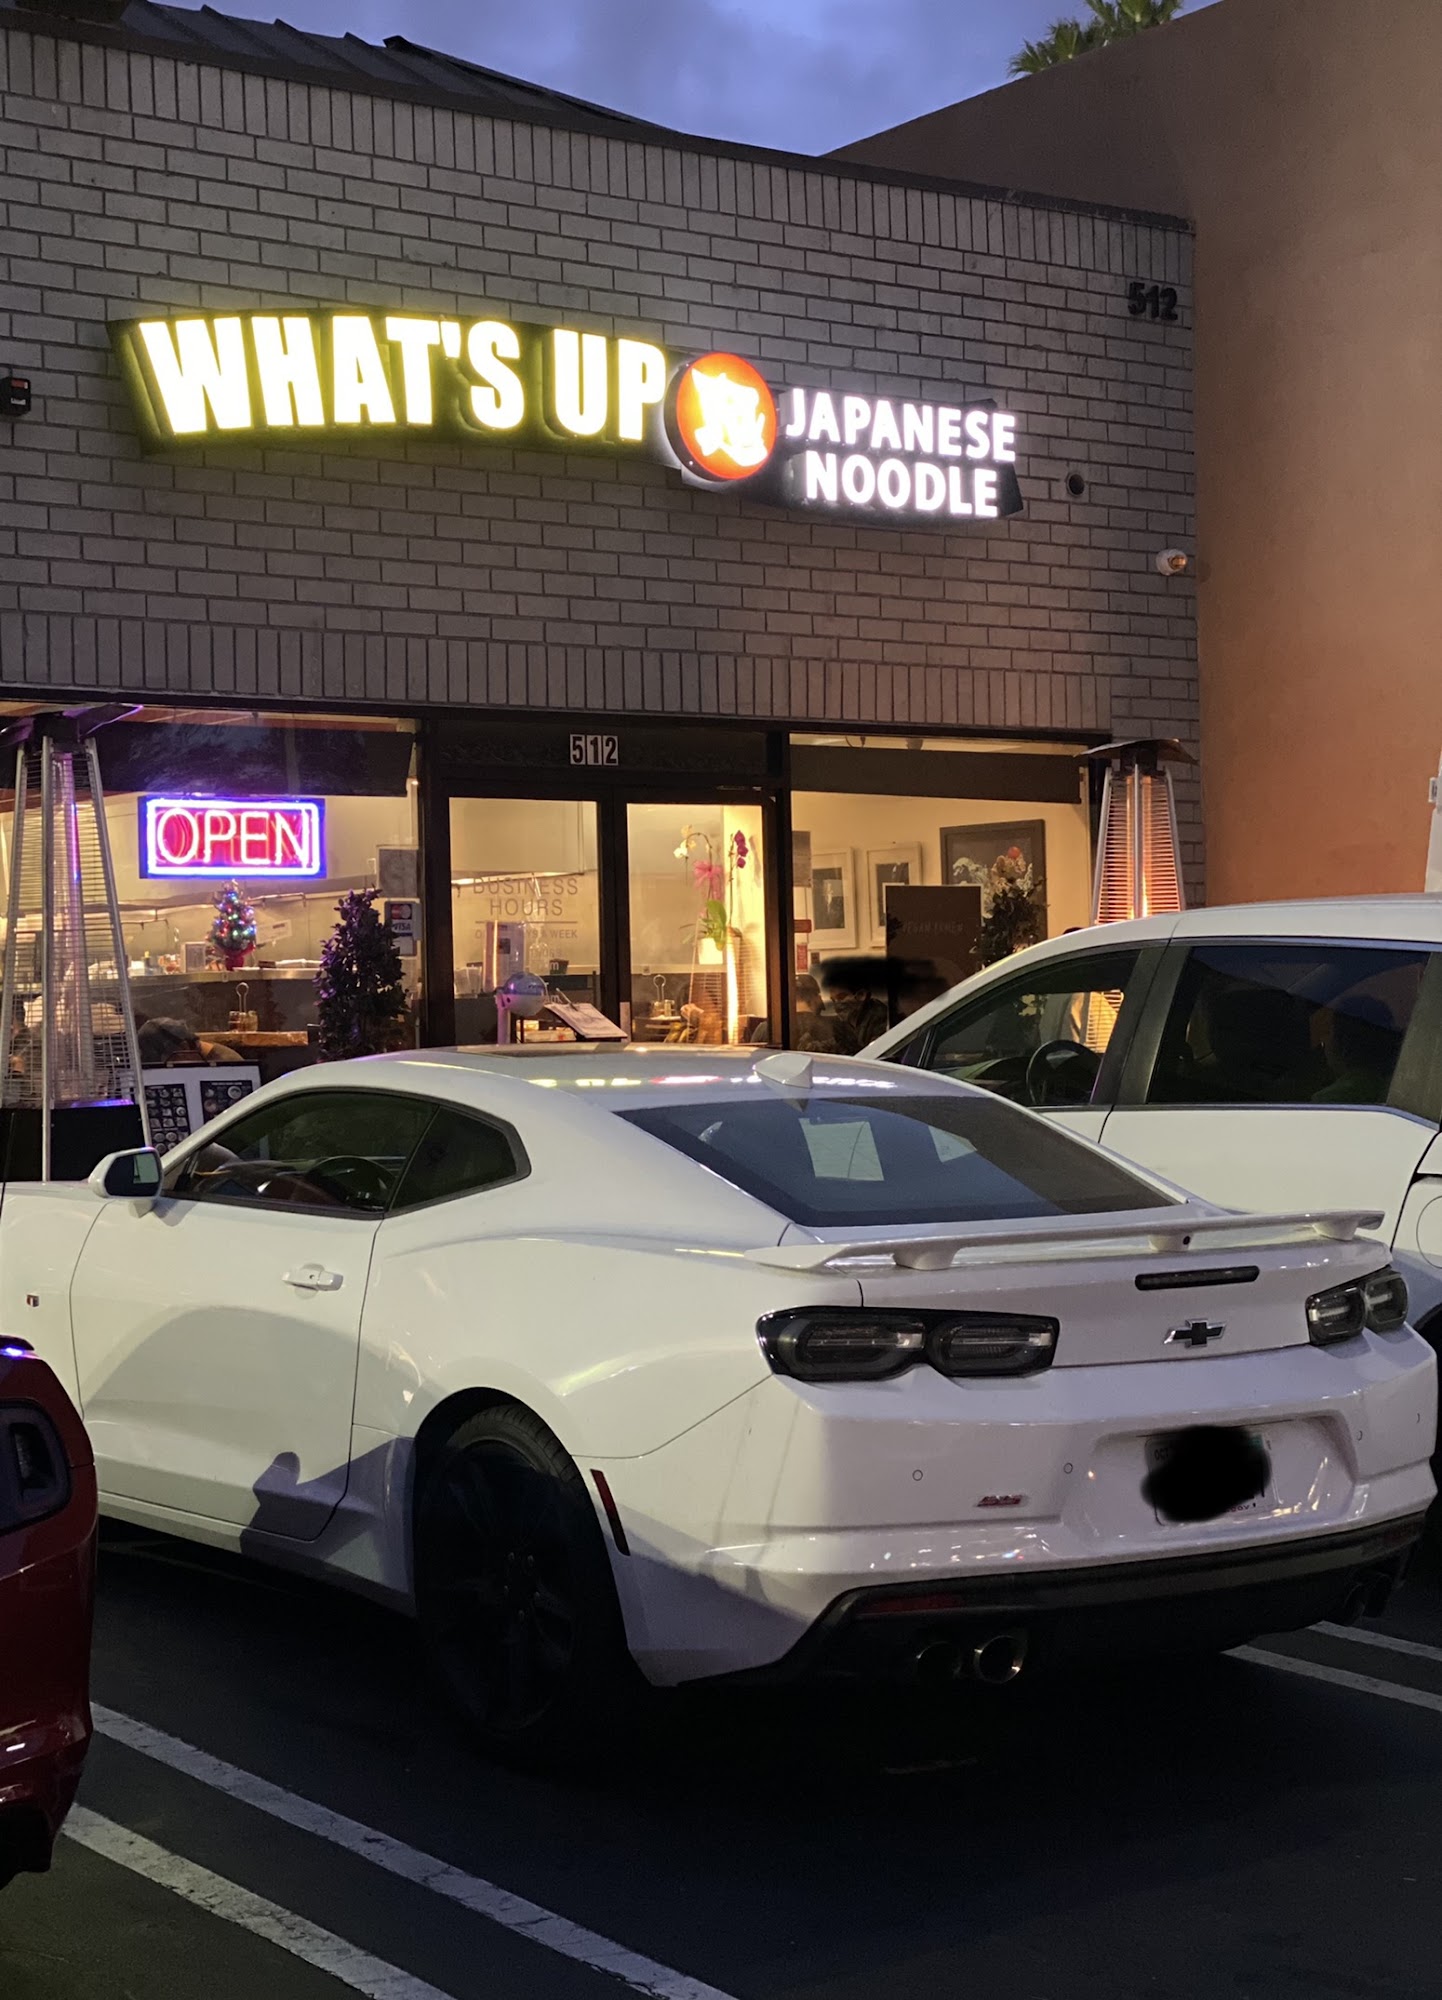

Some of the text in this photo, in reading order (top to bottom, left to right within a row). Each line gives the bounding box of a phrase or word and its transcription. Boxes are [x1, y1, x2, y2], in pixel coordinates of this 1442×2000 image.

[1128, 282, 1178, 319] 512
[138, 315, 525, 434] WHAT'S
[552, 328, 666, 441] UP
[785, 387, 1016, 463] JAPANESE
[805, 450, 999, 518] NOODLE
[572, 736, 617, 764] 512
[156, 806, 310, 868] OPEN
[473, 877, 578, 895] BUSINESS
[489, 898, 563, 916] HOURS
[393, 922, 411, 931] VISA
[551, 929, 578, 939] WEEK
